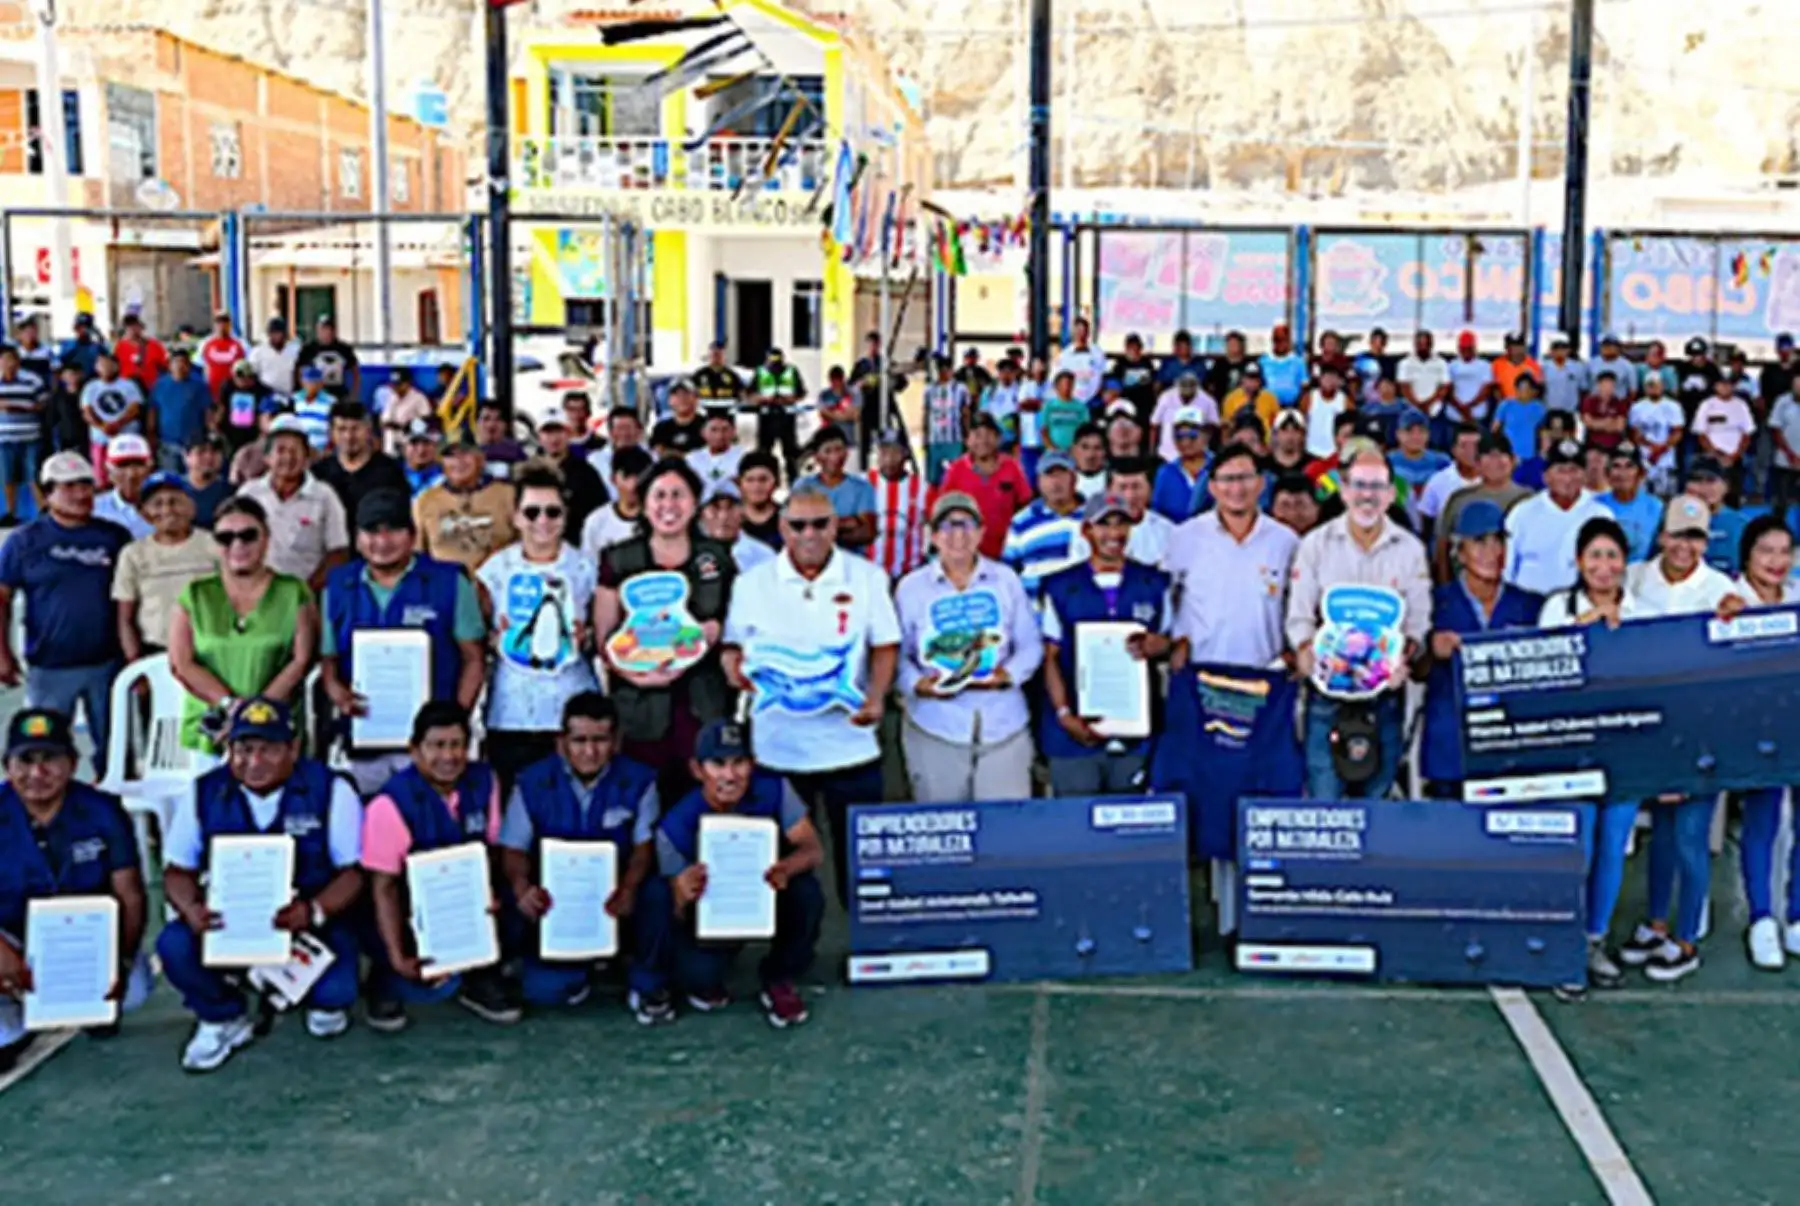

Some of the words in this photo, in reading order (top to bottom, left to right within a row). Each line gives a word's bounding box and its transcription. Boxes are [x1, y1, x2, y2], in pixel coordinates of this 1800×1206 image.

[651, 197, 704, 223] CABO
[713, 198, 789, 225] BLANCO
[1493, 657, 1582, 685] NATURALEZA
[887, 834, 973, 855] NATURALEZA
[1277, 830, 1361, 850] NATURALEZA
